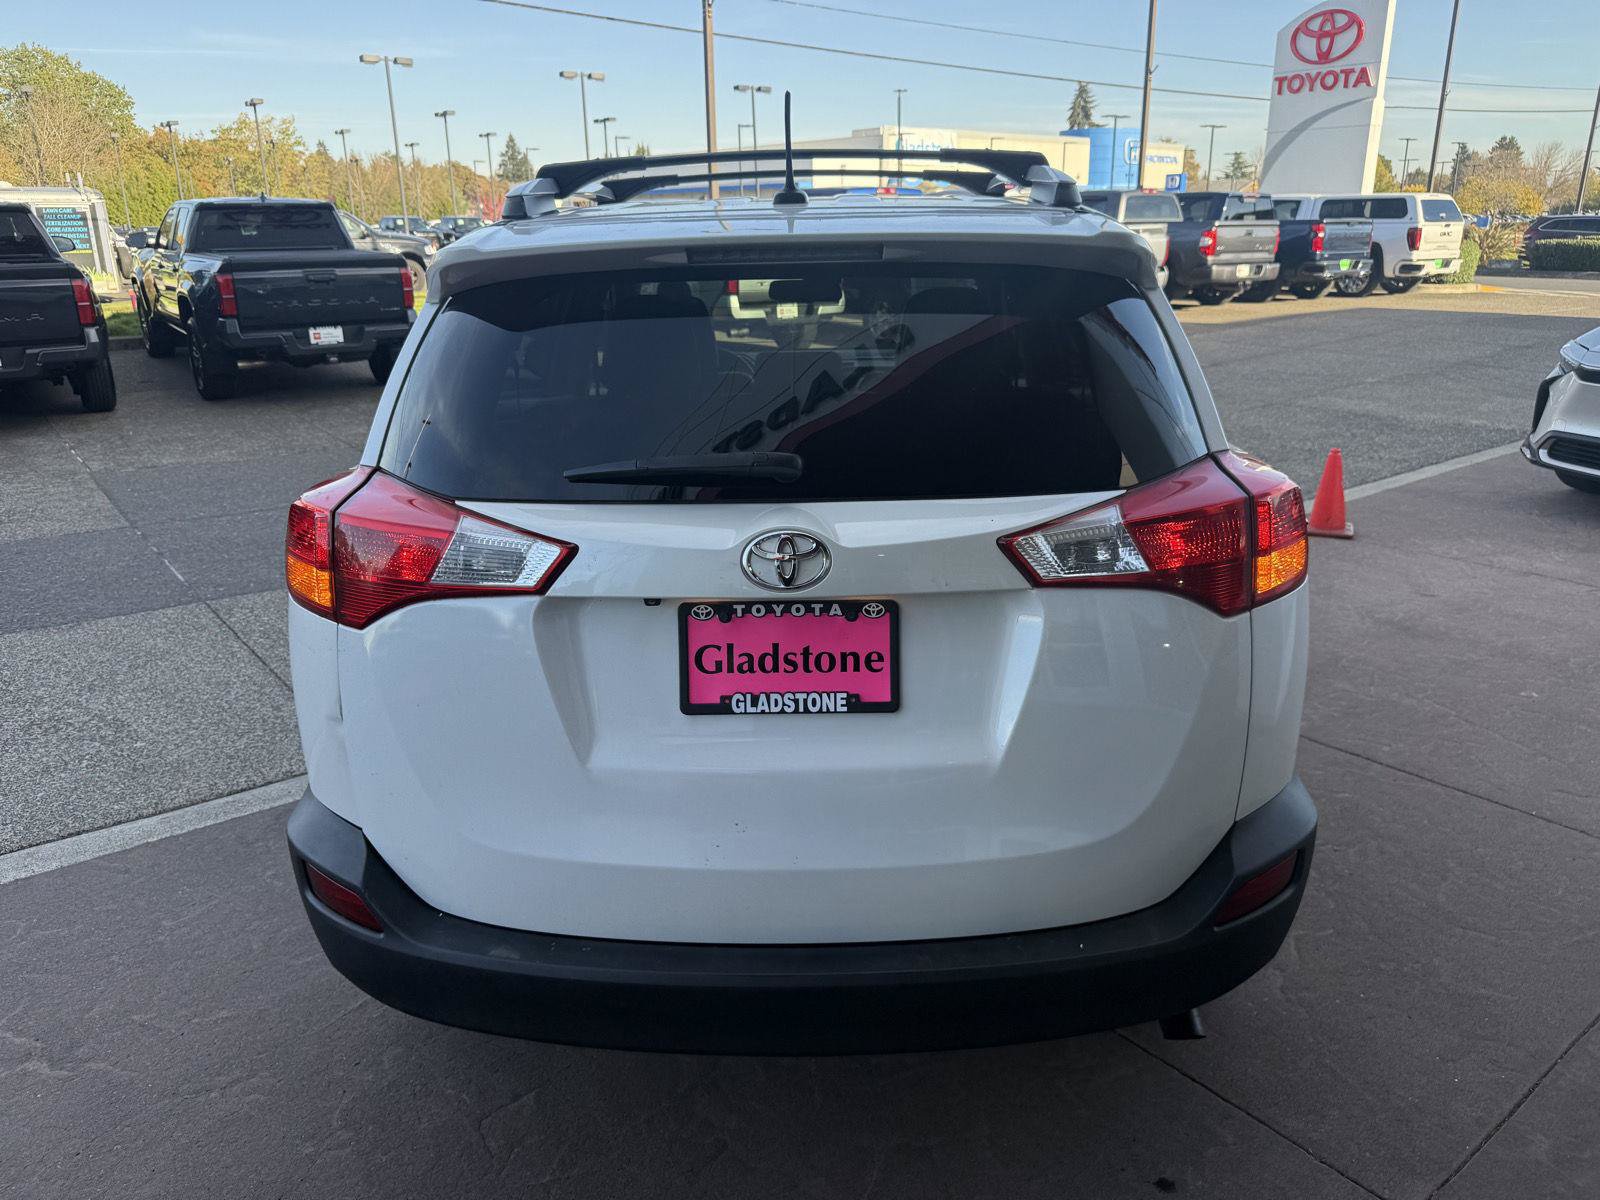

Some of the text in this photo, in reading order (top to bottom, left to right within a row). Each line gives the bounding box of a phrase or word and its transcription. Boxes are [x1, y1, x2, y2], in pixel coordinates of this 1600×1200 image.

[1273, 67, 1375, 96] TOYOTA
[732, 603, 844, 618] TOYOTA
[693, 642, 886, 675] Gladstone
[730, 692, 848, 714] GLADSTONE
